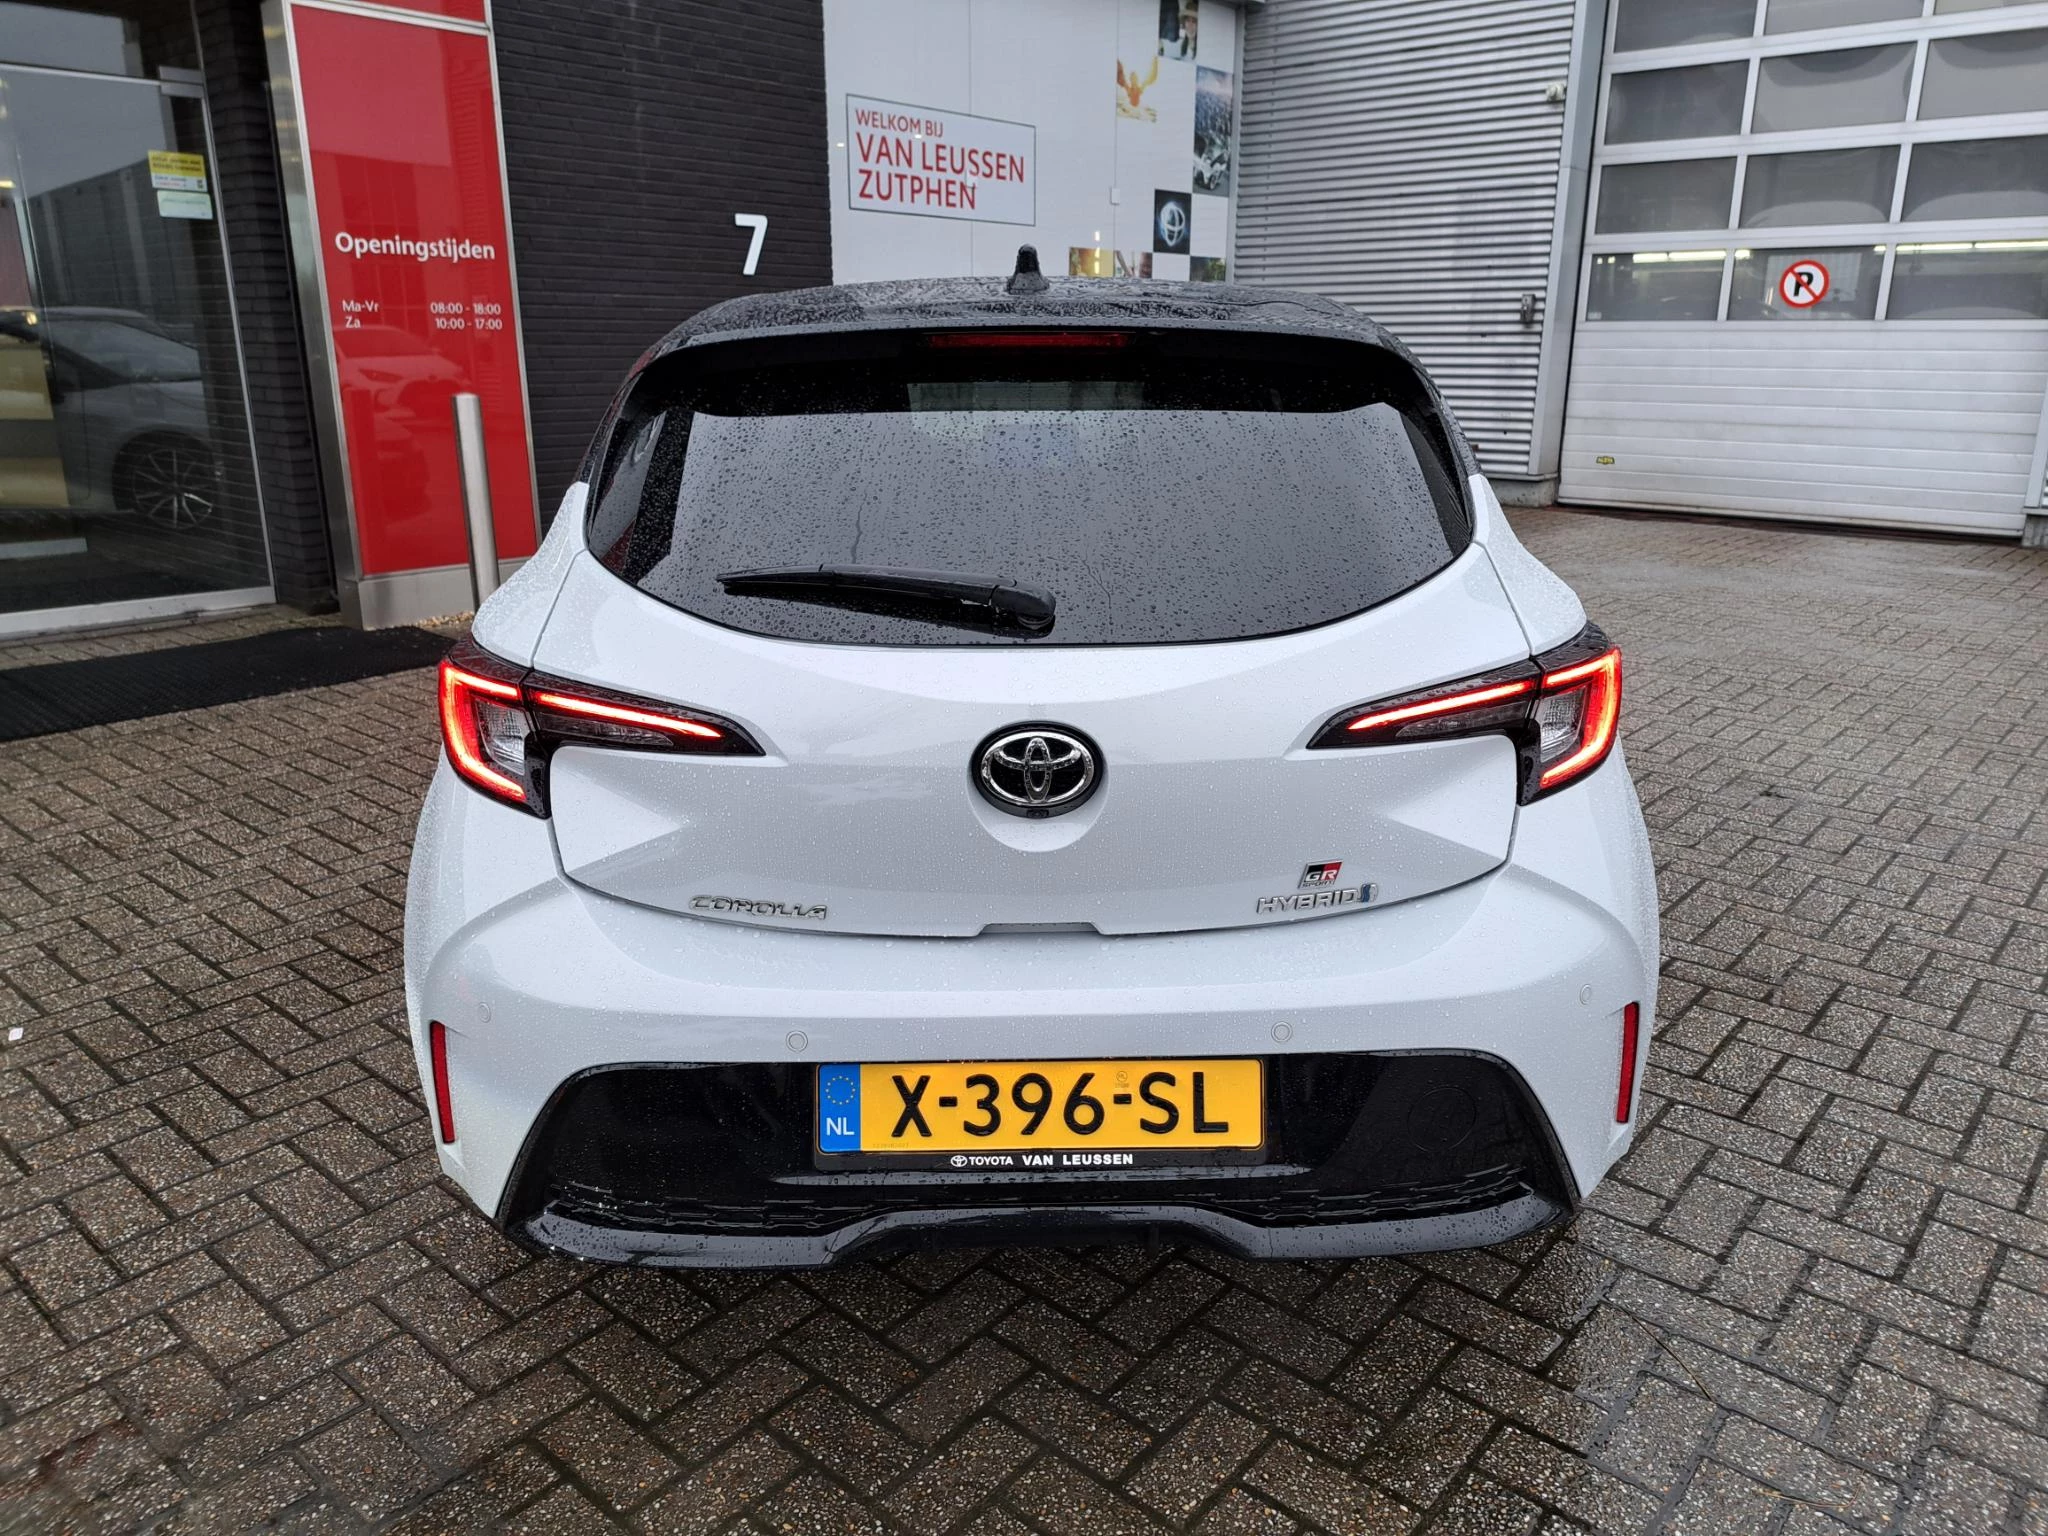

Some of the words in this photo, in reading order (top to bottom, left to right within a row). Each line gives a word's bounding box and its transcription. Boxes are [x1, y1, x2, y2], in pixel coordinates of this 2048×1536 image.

[855, 108, 921, 134] WELKOM
[925, 119, 943, 138] BIJ
[856, 131, 913, 169] VAN
[922, 141, 1024, 184] LEUSSEN
[858, 168, 976, 210] ZUTPHEN
[335, 231, 495, 263] Openingstijden
[734, 212, 768, 275] 7
[1793, 271, 1814, 297] P
[342, 299, 379, 312] Ma-Vr
[430, 302, 463, 314] 08:00
[473, 303, 501, 315] 18:00
[345, 316, 361, 328] Za
[436, 318, 465, 330] 10:00
[475, 318, 503, 330] 17:00
[1305, 869, 1338, 882] GR
[689, 895, 827, 920] COROLLA
[891, 1071, 1229, 1138] X-396-SL
[826, 1117, 855, 1136] NL
[969, 1155, 1014, 1166] TOYOTA
[1022, 1154, 1054, 1166] VAN
[1063, 1153, 1133, 1165] LEUSSEN
